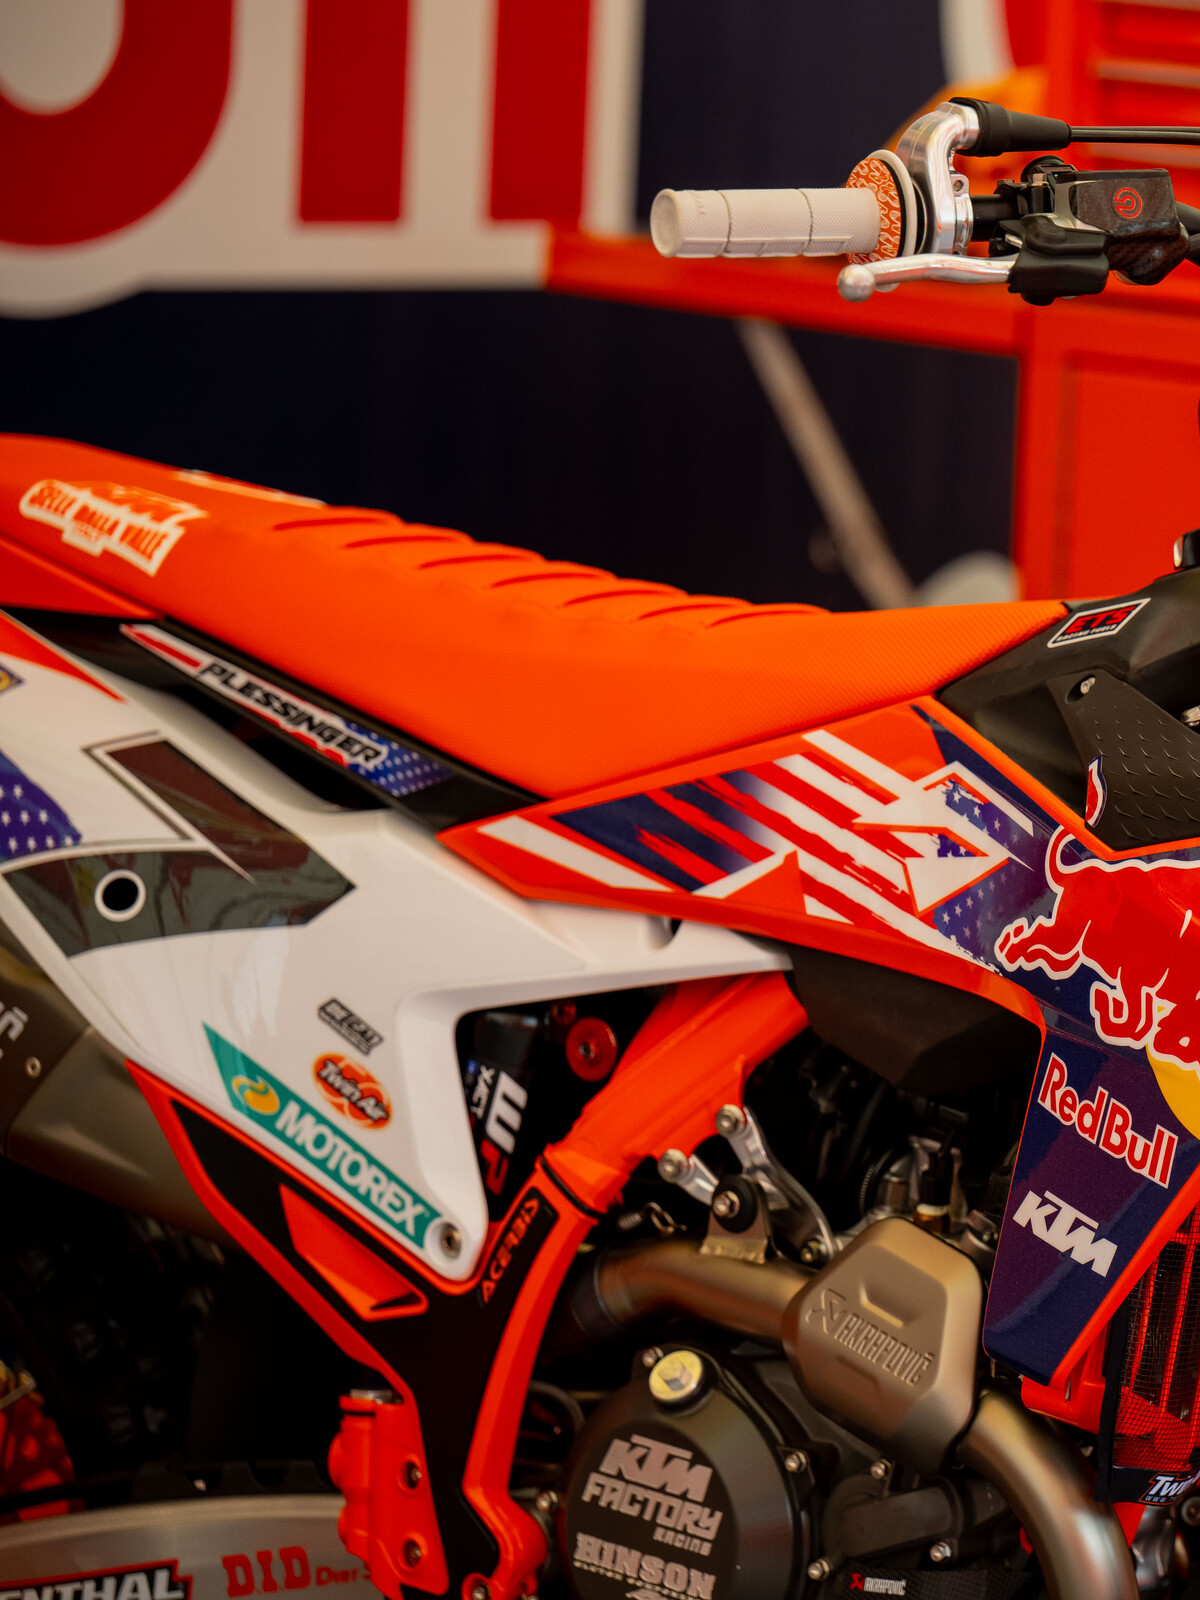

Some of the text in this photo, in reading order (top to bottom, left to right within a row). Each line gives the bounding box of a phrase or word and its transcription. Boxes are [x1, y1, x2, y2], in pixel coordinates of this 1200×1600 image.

[1064, 605, 1137, 634] ETS
[199, 660, 383, 765] PLESSINGER
[1038, 1052, 1178, 1189] Red Bull
[275, 1100, 426, 1237] MOTOREX
[481, 1197, 540, 1306] ACERBIS
[1013, 1190, 1118, 1277] KTM
[599, 1434, 713, 1503] KTM
[581, 1472, 724, 1541] FACTORY
[573, 1532, 716, 1600] HINSON
[653, 1527, 712, 1557] RACING
[0, 1567, 185, 1600] THAL
